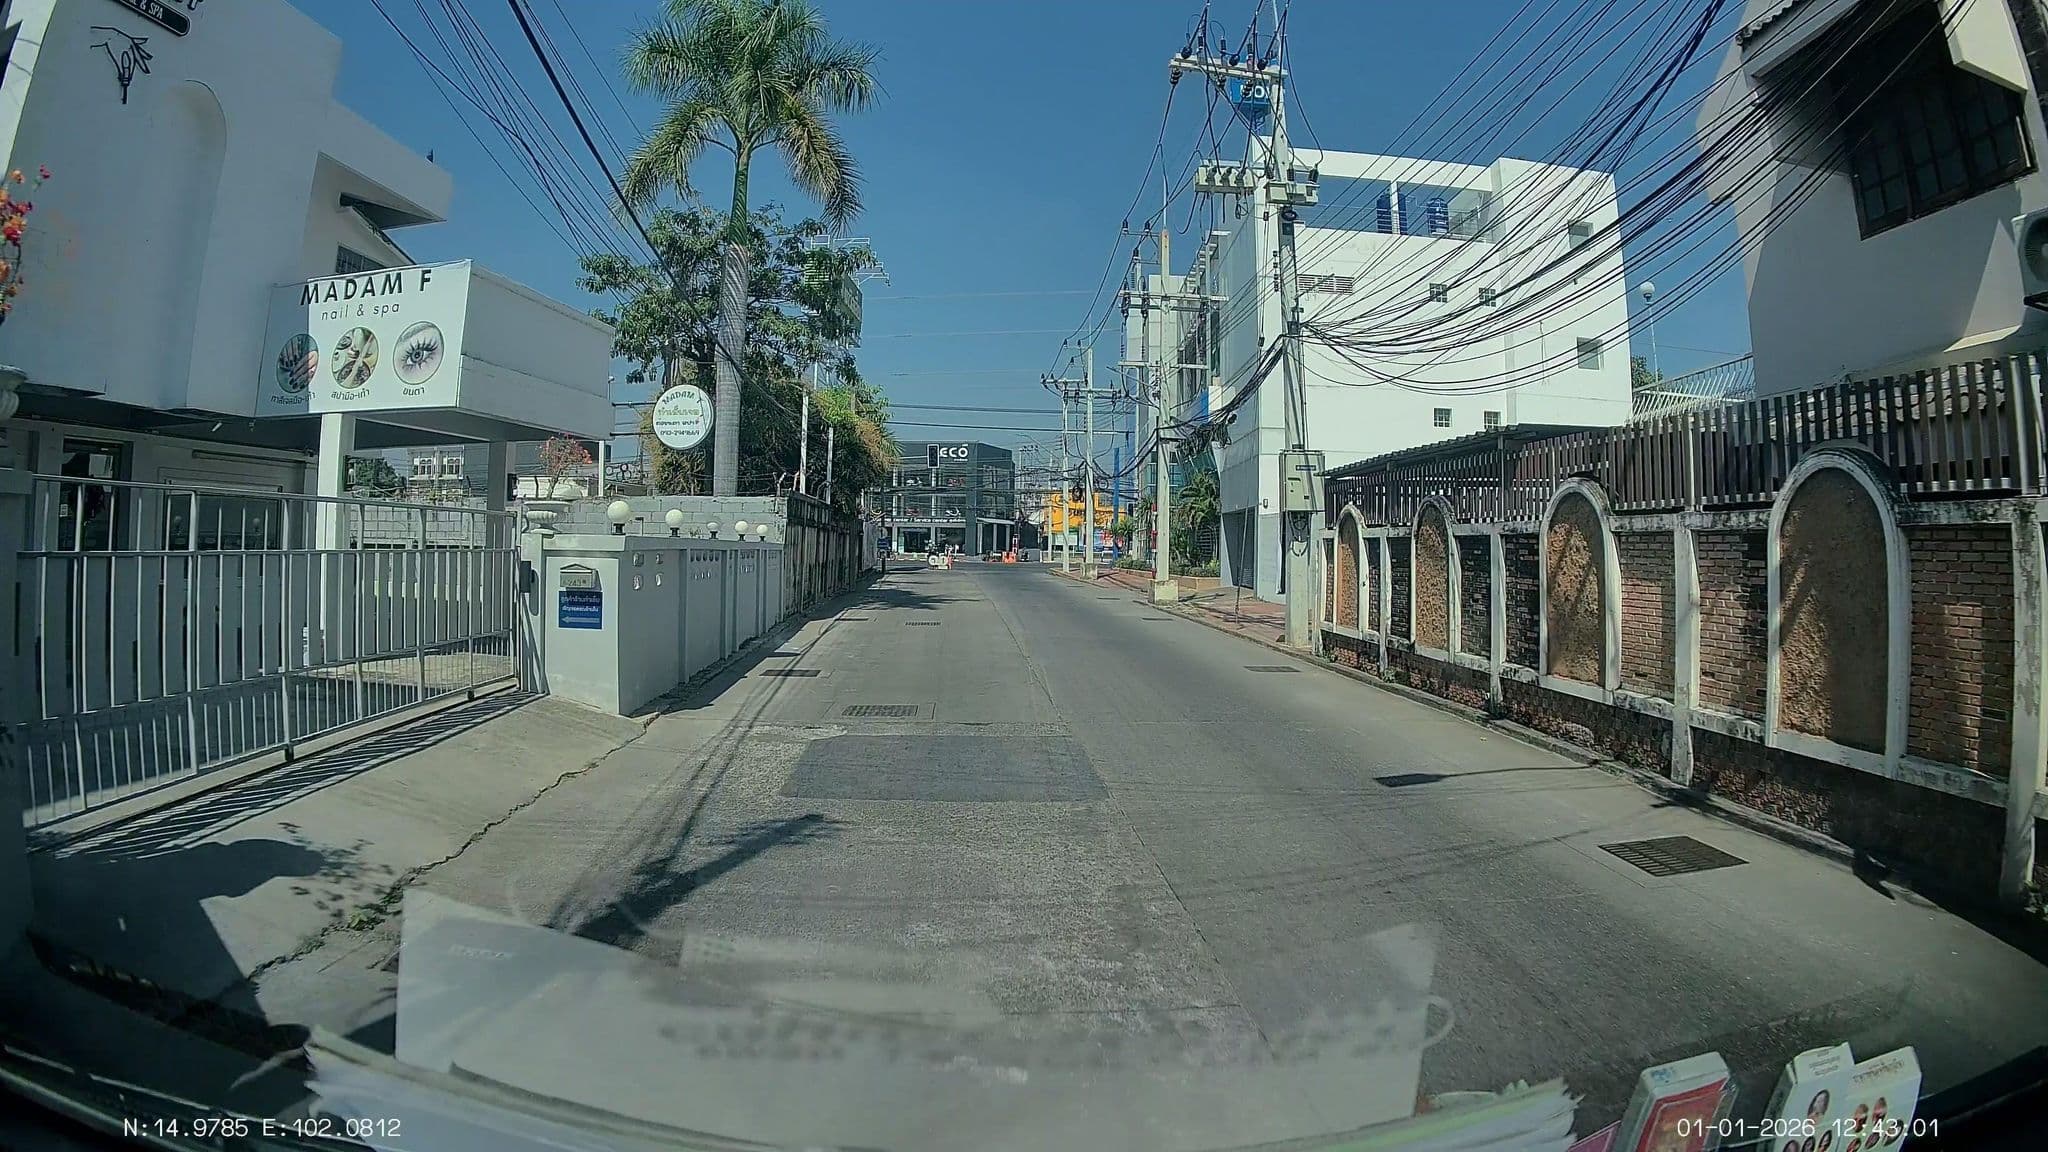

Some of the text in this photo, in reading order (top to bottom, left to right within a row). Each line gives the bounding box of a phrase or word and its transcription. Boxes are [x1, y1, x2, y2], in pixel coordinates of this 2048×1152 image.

[148, 2, 164, 20] SPA
[300, 269, 432, 306] MADAM F
[321, 303, 400, 321] nail & spa
[331, 388, 370, 401] สปามือ-เท้า
[402, 386, 425, 396] ขนตา
[662, 390, 695, 405] MADAM
